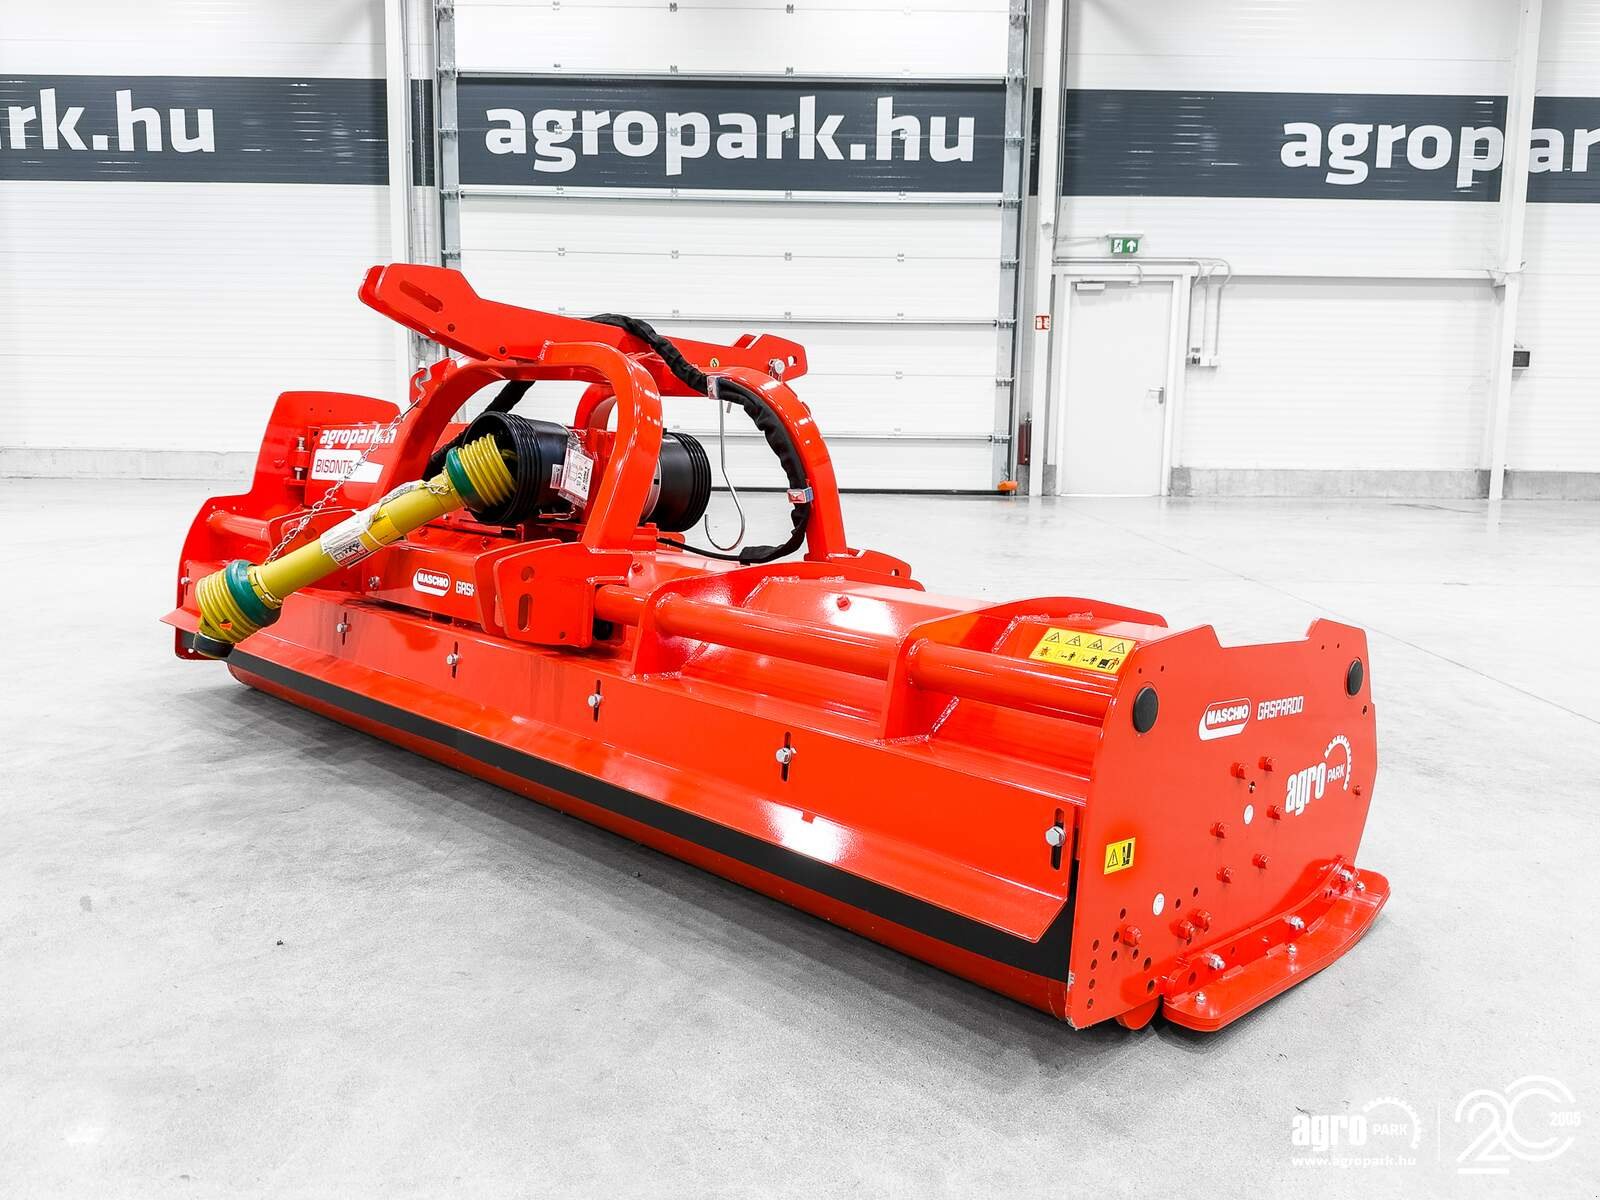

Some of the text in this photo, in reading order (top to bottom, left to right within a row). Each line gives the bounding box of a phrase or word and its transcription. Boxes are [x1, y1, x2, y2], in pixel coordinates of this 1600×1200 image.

[0, 88, 215, 153] rk.hu
[485, 95, 975, 176] agropark.hu
[417, 572, 449, 588] MASCHIO
[1206, 696, 1304, 725] MASCHIO GASPARDO
[1285, 762, 1346, 816] agro PARK
